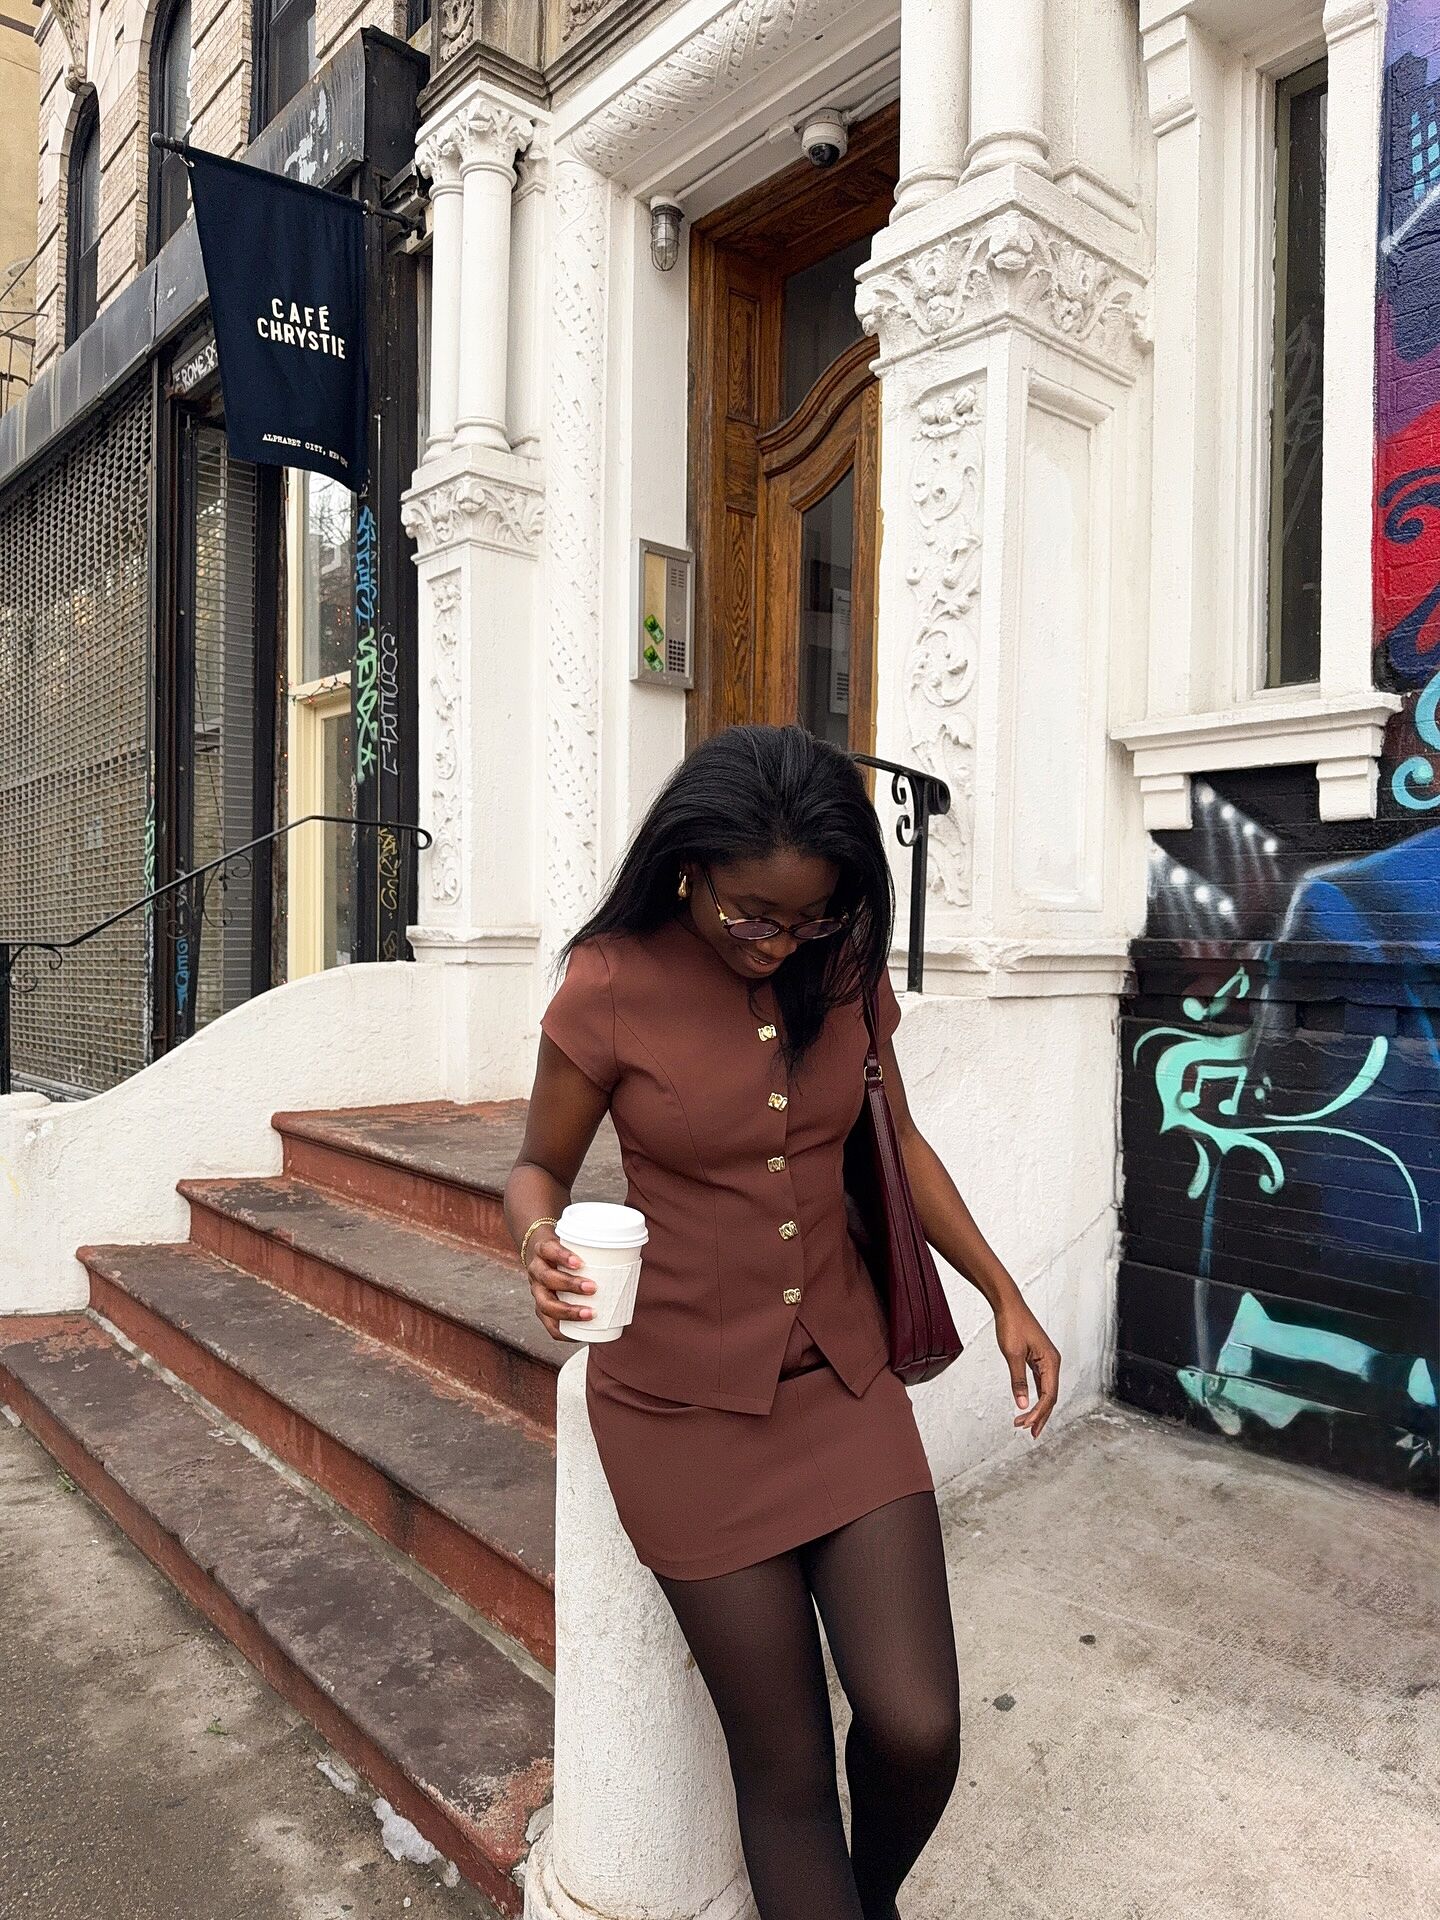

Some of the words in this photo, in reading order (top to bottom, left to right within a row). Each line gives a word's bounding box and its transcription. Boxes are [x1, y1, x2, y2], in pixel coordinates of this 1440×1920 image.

[271, 298, 331, 331] CAFÉ
[256, 317, 346, 360] CHRYSTIE
[262, 433, 302, 447] ALPHABET
[304, 442, 326, 456] CITY,
